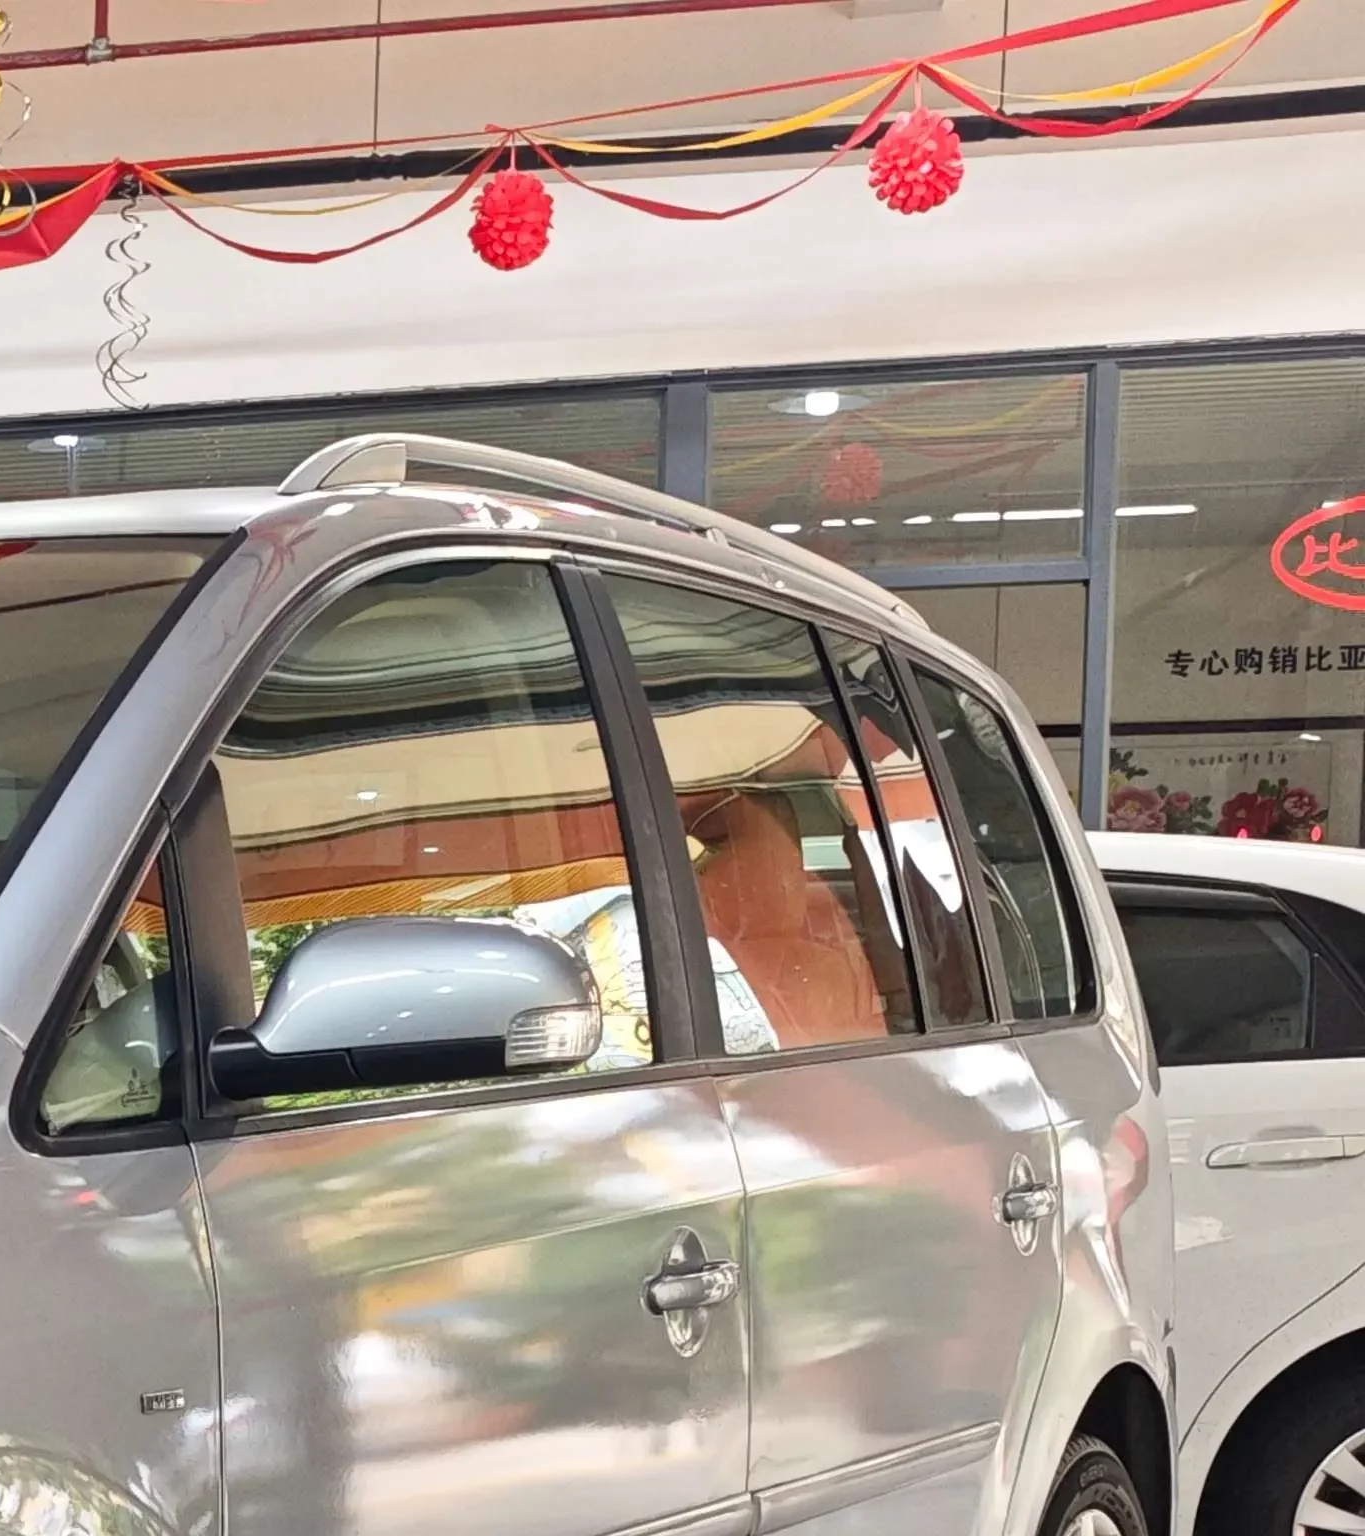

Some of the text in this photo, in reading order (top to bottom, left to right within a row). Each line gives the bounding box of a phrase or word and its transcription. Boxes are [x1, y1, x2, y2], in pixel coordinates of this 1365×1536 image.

[1165, 645, 1365, 678] 专心购销比亚
